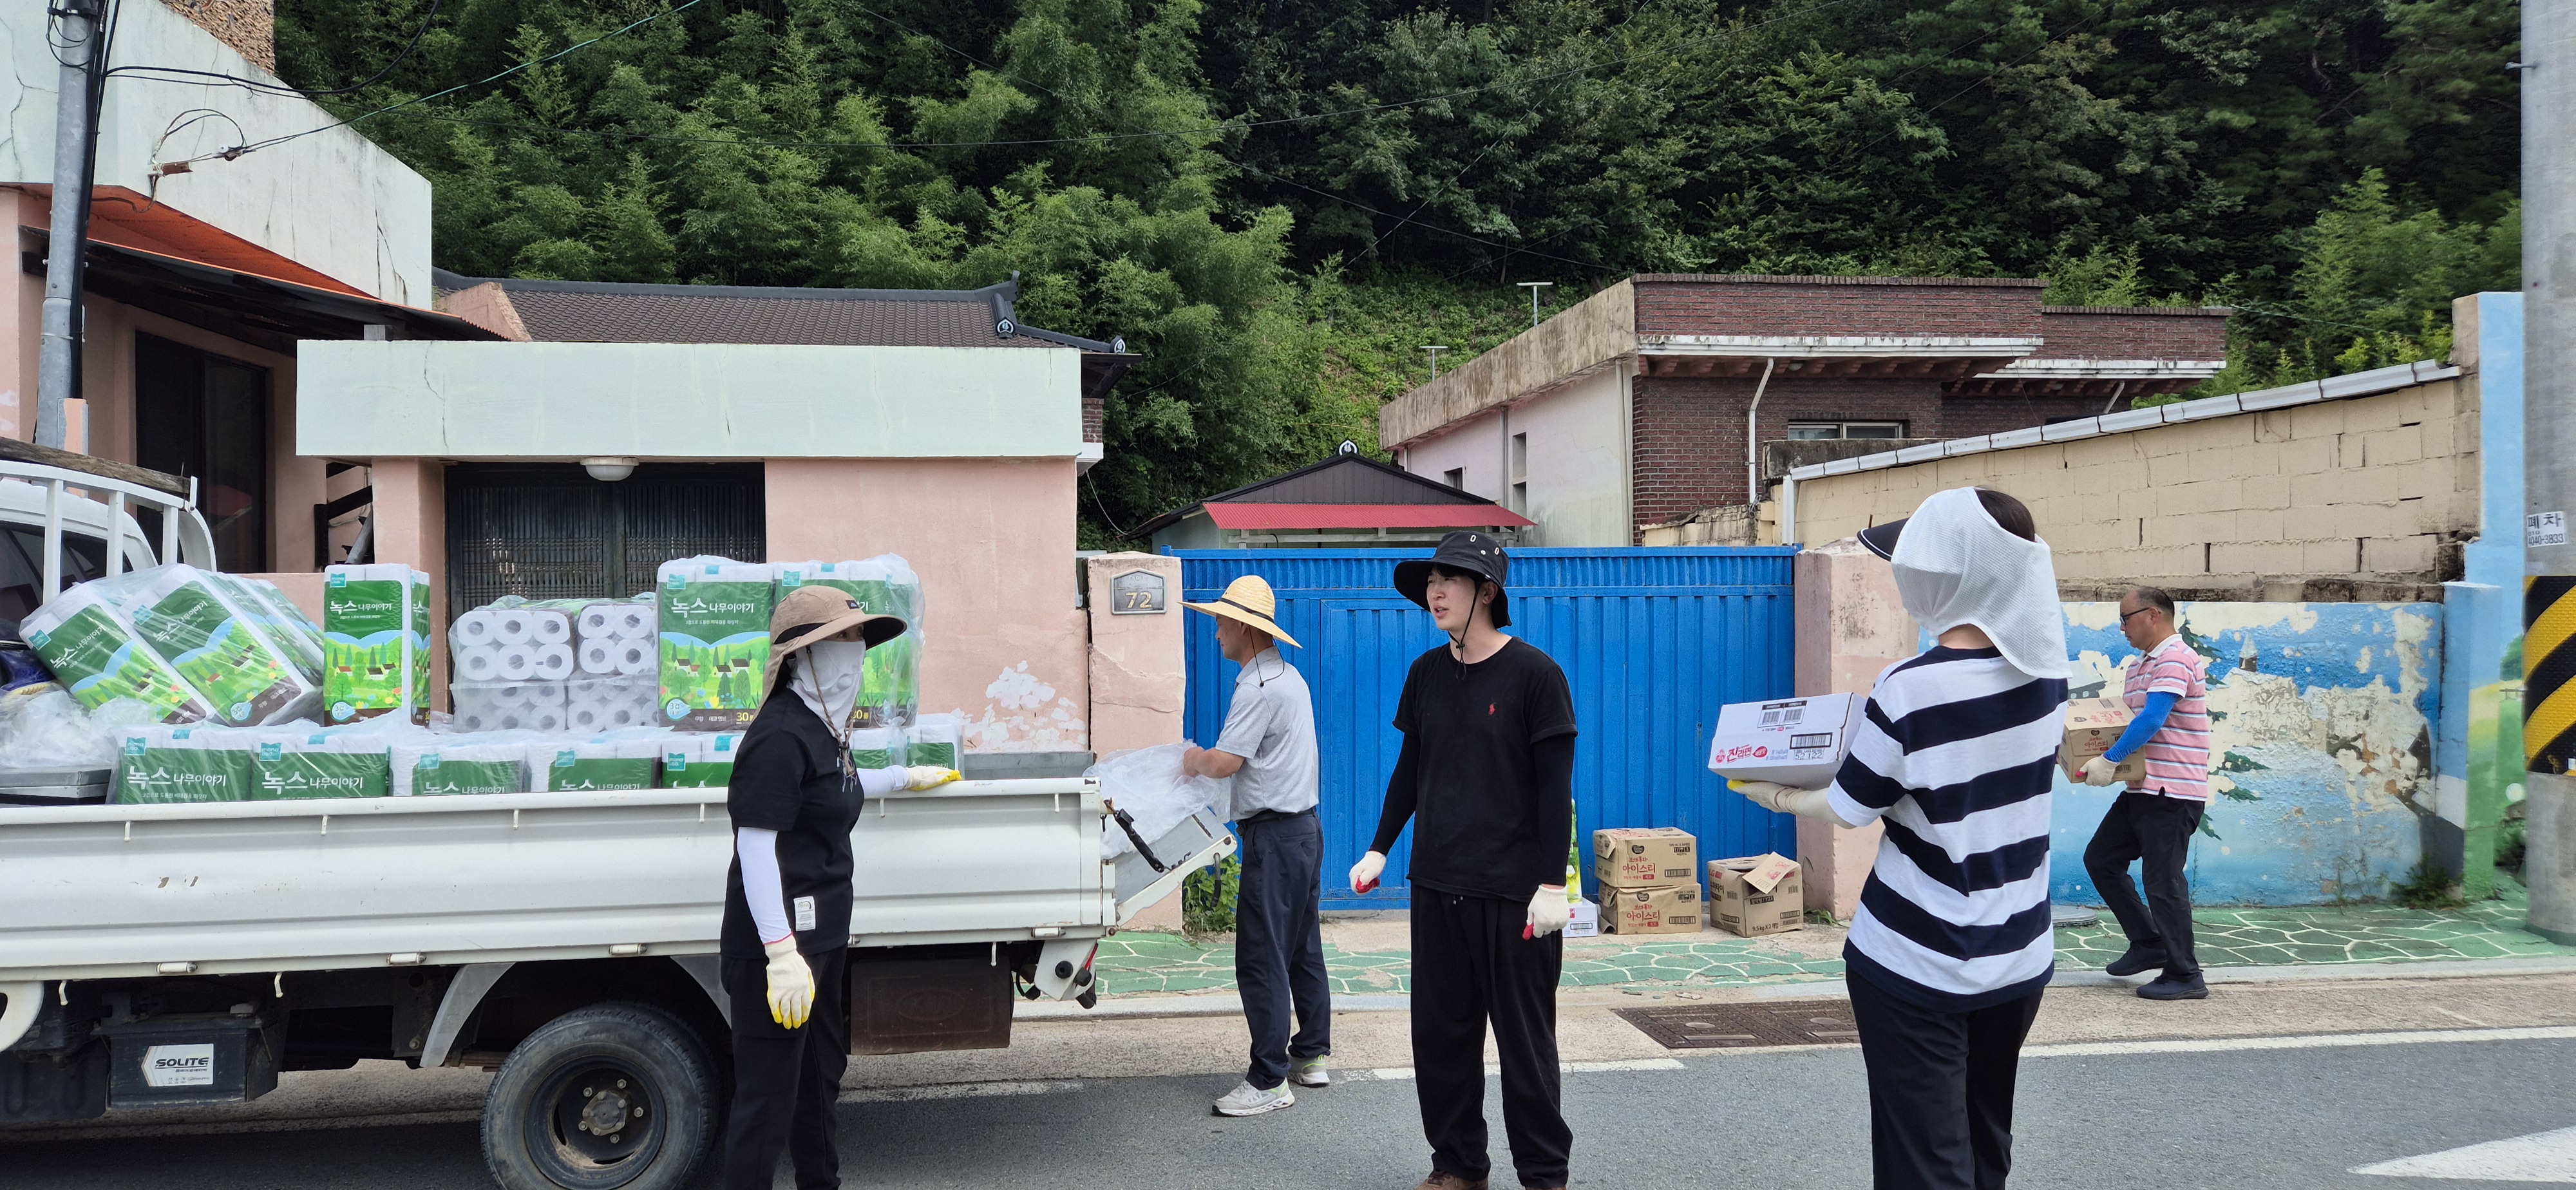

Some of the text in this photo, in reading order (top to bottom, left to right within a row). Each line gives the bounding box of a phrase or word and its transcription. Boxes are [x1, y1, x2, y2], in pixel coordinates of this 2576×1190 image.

[330, 601, 358, 615] 녹스
[671, 598, 754, 618] 녹스 나무이야기
[1125, 592, 1152, 609] 72
[153, 621, 181, 643] 녹스
[178, 600, 208, 623] 나무이야기
[50, 647, 79, 669] 녹스
[127, 766, 226, 789] 녹스 나무이야기
[261, 771, 363, 795] 녹스 나무이야기
[1622, 863, 1655, 874] 아이스티
[1627, 910, 1660, 921] 아이스티
[155, 1057, 209, 1067] SOLITE
